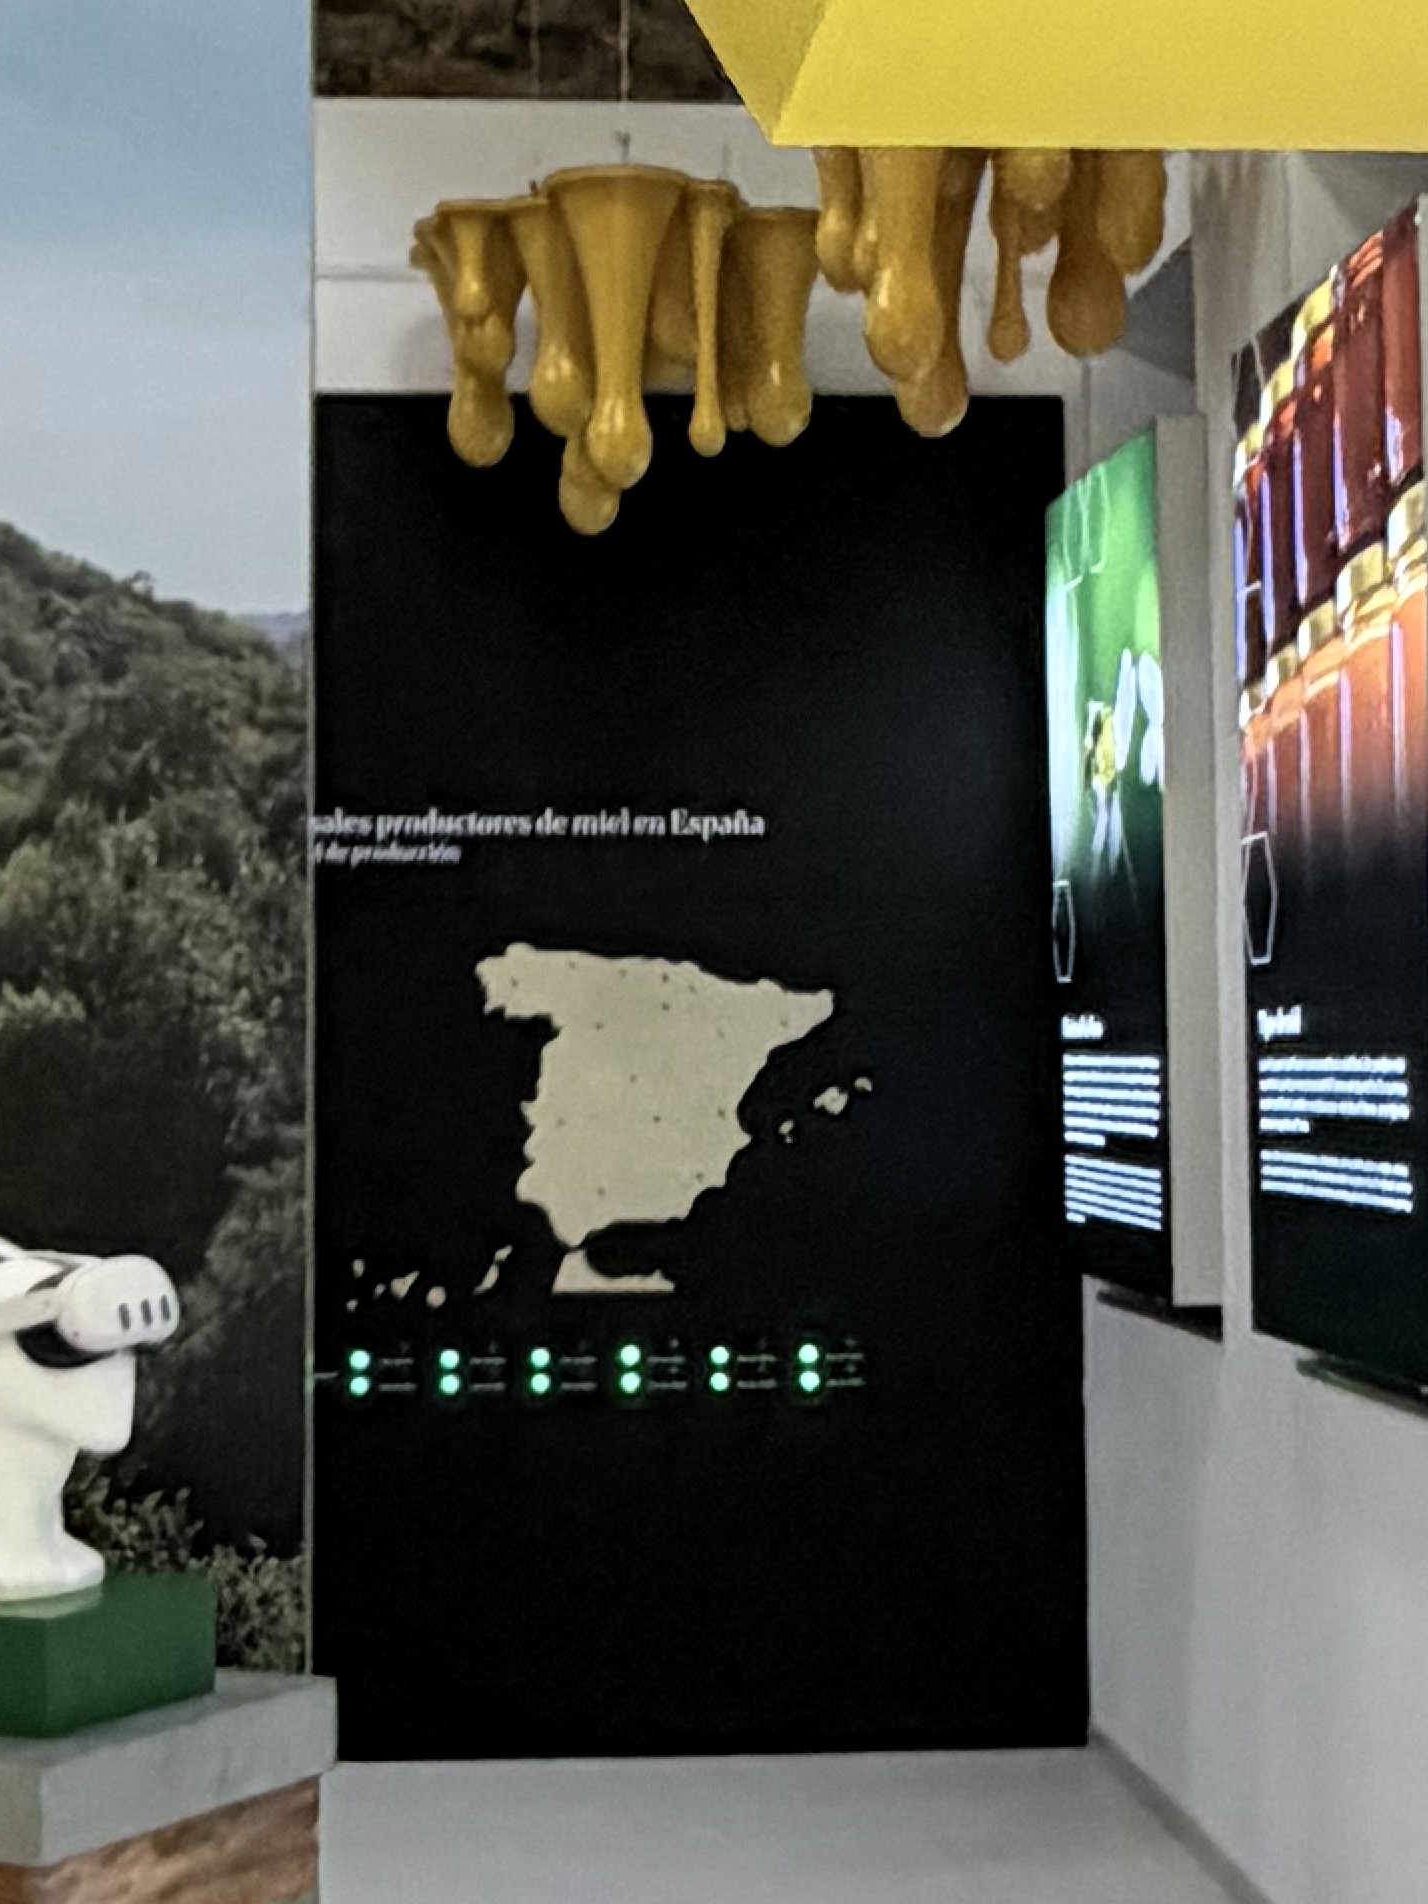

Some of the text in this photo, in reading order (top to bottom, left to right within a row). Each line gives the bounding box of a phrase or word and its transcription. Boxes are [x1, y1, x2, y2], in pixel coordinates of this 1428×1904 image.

[376, 806, 533, 843] productores
[535, 806, 569, 836] de
[571, 806, 631, 836] miel
[633, 814, 667, 836] en
[669, 806, 767, 844] España
